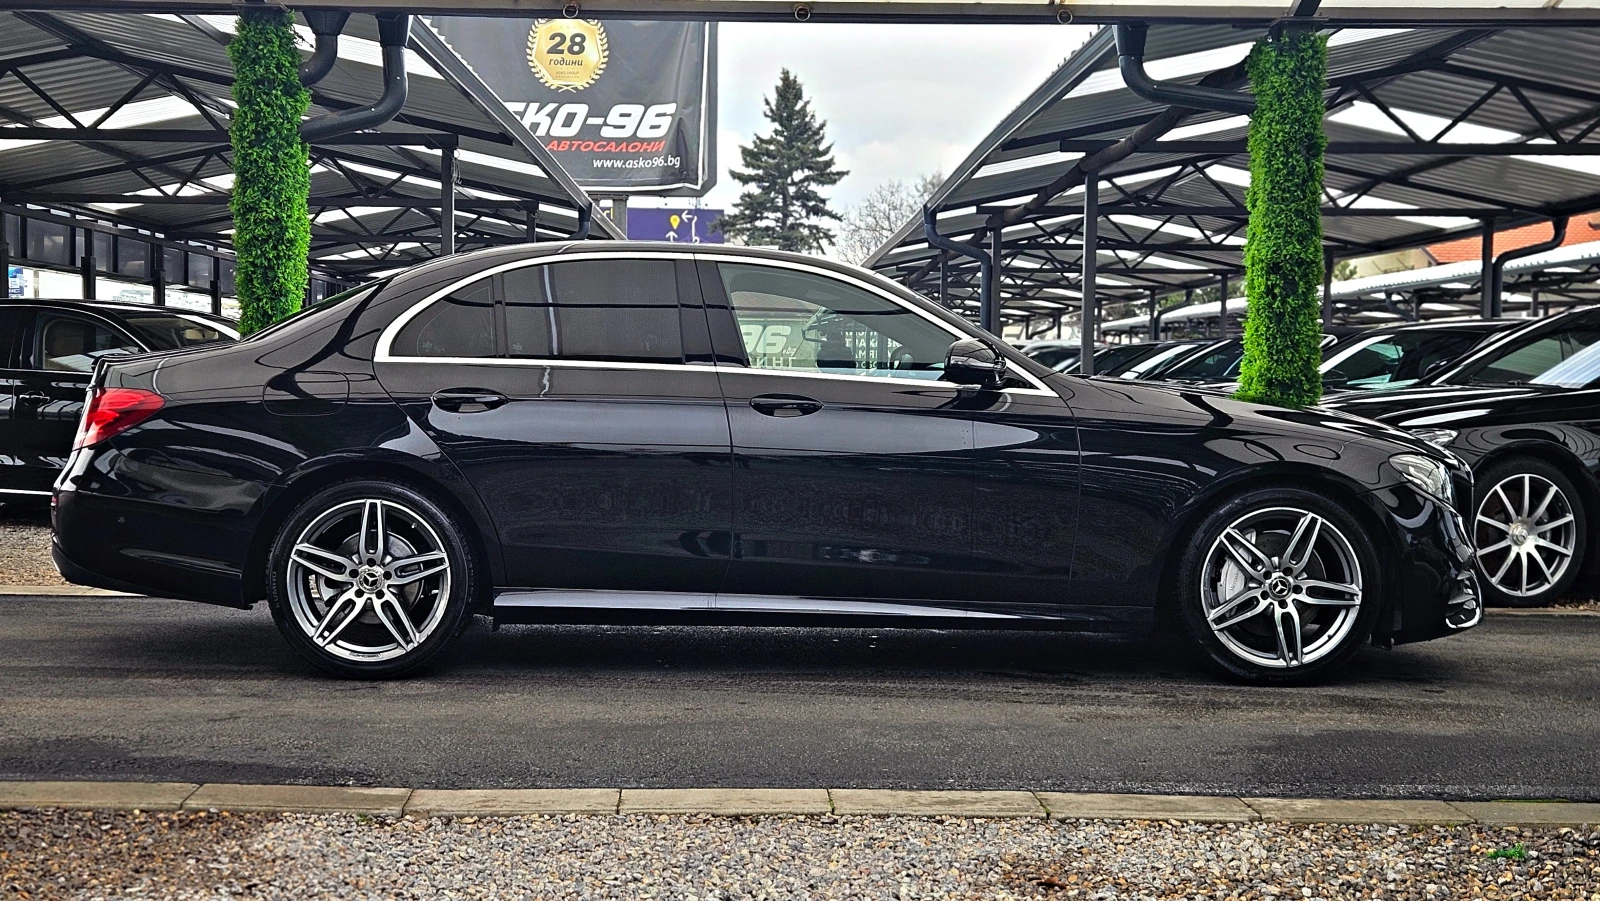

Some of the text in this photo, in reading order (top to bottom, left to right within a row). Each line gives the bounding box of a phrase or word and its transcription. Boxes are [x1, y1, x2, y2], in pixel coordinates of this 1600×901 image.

[546, 32, 587, 55] 28
[548, 57, 584, 67] години
[546, 140, 666, 152] АВТОСАЛОНИ
[593, 155, 681, 169] www.asko96.bg
[271, 571, 280, 608] KUMHO
